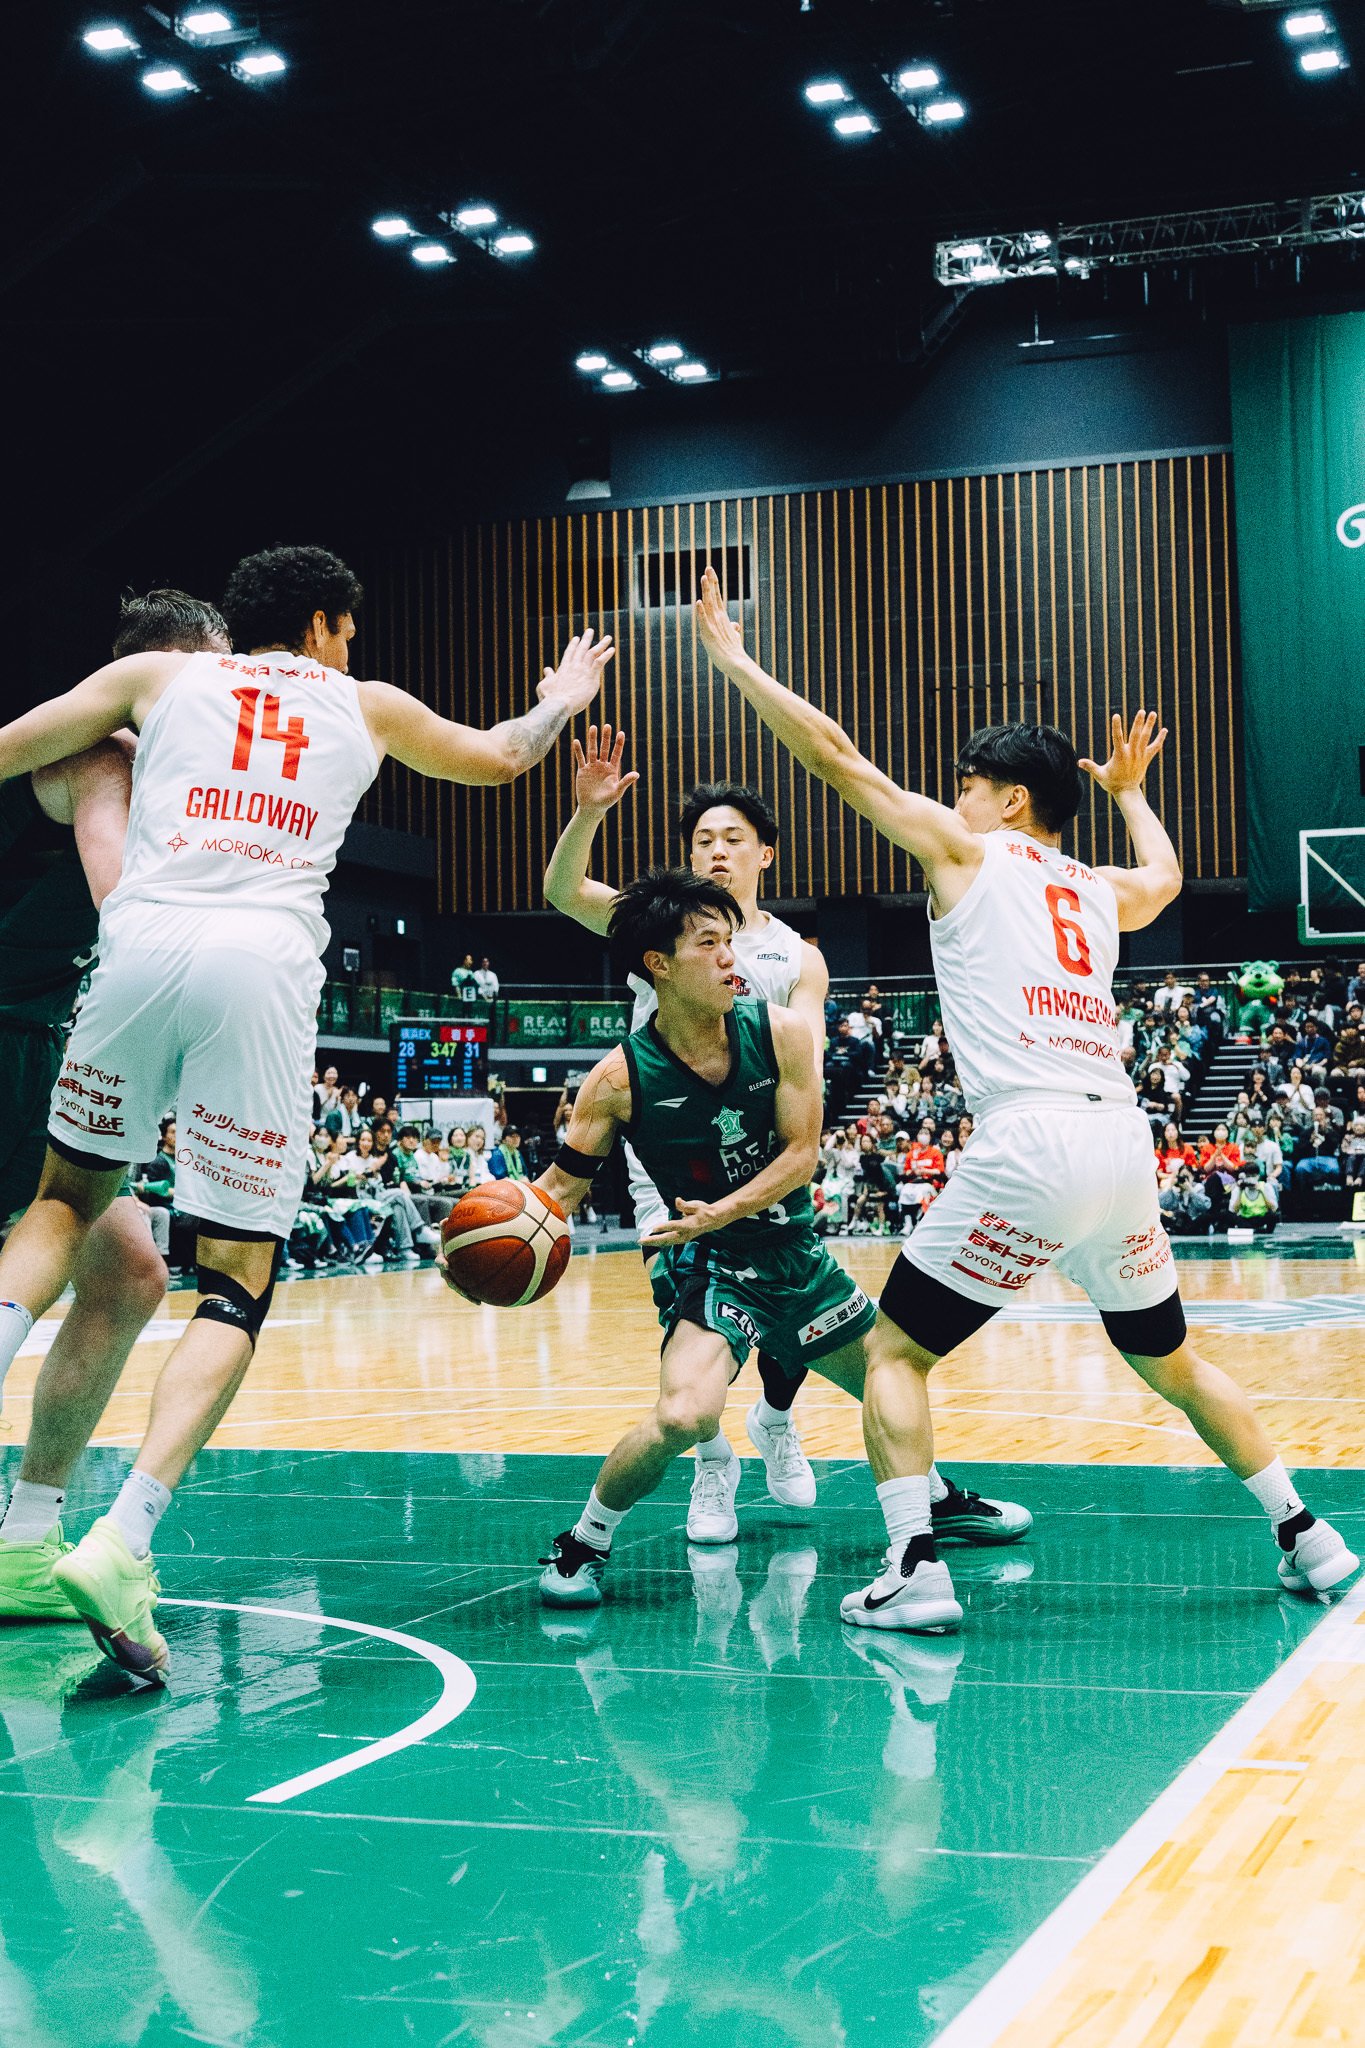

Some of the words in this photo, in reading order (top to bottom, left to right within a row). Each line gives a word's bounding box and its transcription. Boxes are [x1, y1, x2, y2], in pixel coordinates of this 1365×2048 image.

[231, 687, 309, 781] 14
[185, 786, 319, 841] GALLOWAY
[201, 838, 285, 866] MORIOKA
[1045, 883, 1093, 977] 6
[398, 1041, 416, 1057] 28
[430, 1042, 457, 1058] 3:47
[464, 1042, 480, 1058] 31
[1048, 1036, 1116, 1061] MORIOKA
[89, 1111, 124, 1131] L&F
[719, 1116, 739, 1134] EX
[192, 1160, 221, 1181] SATO
[222, 1175, 276, 1198] KOUSAN
[968, 1229, 1051, 1267] 岩手トヨタ
[979, 1211, 1065, 1253] 岩手トヨペット
[960, 1247, 1003, 1274] TOYOTA
[824, 1294, 866, 1330] 三菱地所
